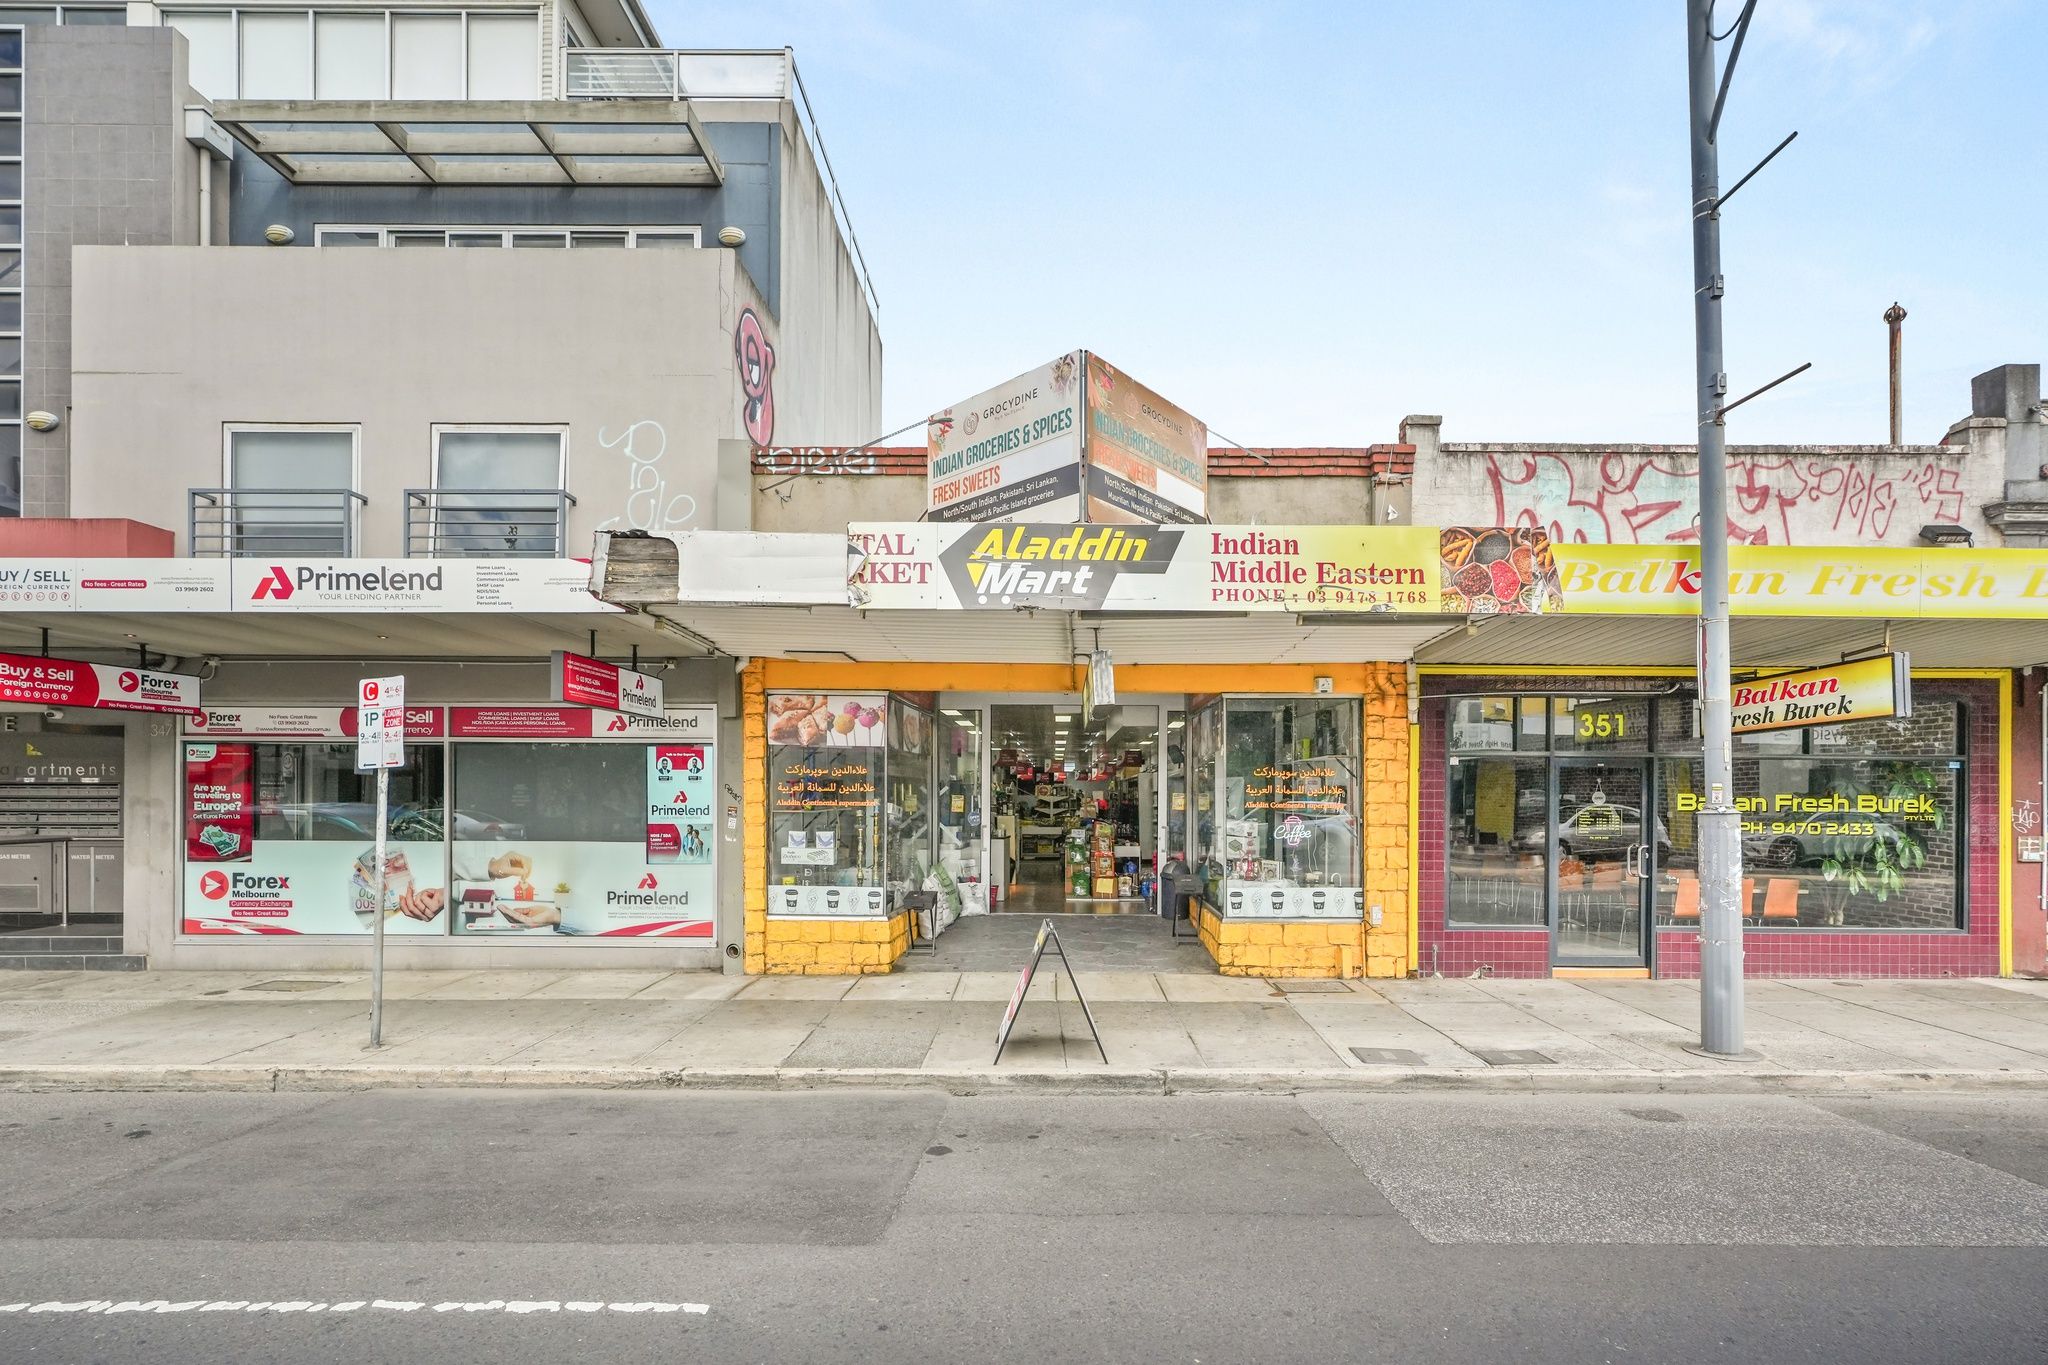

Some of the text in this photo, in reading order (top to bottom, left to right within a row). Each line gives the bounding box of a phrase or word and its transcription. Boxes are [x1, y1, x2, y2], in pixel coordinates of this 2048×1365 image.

[983, 387, 1039, 420] GROCYDINE
[1141, 404, 1183, 435] GROCYDINE
[932, 407, 1073, 479] INDIAN GROCERIES & SPICES
[932, 464, 1001, 506] FRESH SWEETS
[1104, 474, 1138, 498] North/South
[943, 501, 978, 519] North/South
[1026, 482, 1035, 492] Sri
[970, 509, 987, 522] Nepali
[992, 502, 1010, 515] Pacific
[1010, 498, 1027, 510] Island
[1027, 489, 1055, 506] groceries
[1149, 508, 1163, 522] Pacific
[863, 533, 915, 556] TAL
[1211, 532, 1300, 555] Indian
[0, 570, 70, 582] UY SELL
[297, 565, 442, 591] Primelend
[977, 562, 1093, 595] Mart
[1211, 561, 1426, 585] Middle Eastern
[1806, 562, 1996, 597] Fresh
[318, 593, 422, 601] YOUR LENDING PARTNER
[1211, 588, 1427, 604] PHONE 03 9478 1768
[0, 662, 74, 682] Buy & Sell
[34, 681, 74, 693] Currency
[140, 674, 179, 690] Forex
[140, 687, 173, 695] Melbourne
[366, 683, 376, 699] C
[622, 688, 657, 709] Primelend
[1732, 677, 1840, 708] Balkan
[208, 712, 241, 722] Forex
[364, 712, 379, 727] 1P
[384, 708, 402, 717] LOADING
[405, 710, 434, 724] Sell
[1731, 695, 1853, 728] resh Burek
[385, 719, 401, 727] ZONE
[628, 715, 698, 728] Primelend
[1579, 713, 1624, 737] 351
[150, 723, 173, 737] 347
[193, 784, 226, 793] Are you
[193, 792, 231, 800] traveling
[777, 782, 804, 794] العربية
[1245, 784, 1273, 796] العربية
[193, 801, 242, 813] Europe?
[651, 804, 710, 816] Primelend
[1676, 792, 1767, 813] Baan
[1775, 792, 1843, 813] Fresh
[1857, 792, 1935, 813] Burek
[1274, 824, 1312, 843] Coffee
[1740, 823, 1874, 835] PH: 9470 2433
[232, 872, 290, 889] Forex
[232, 890, 280, 898] Melbourne
[607, 890, 689, 905] Primelend
